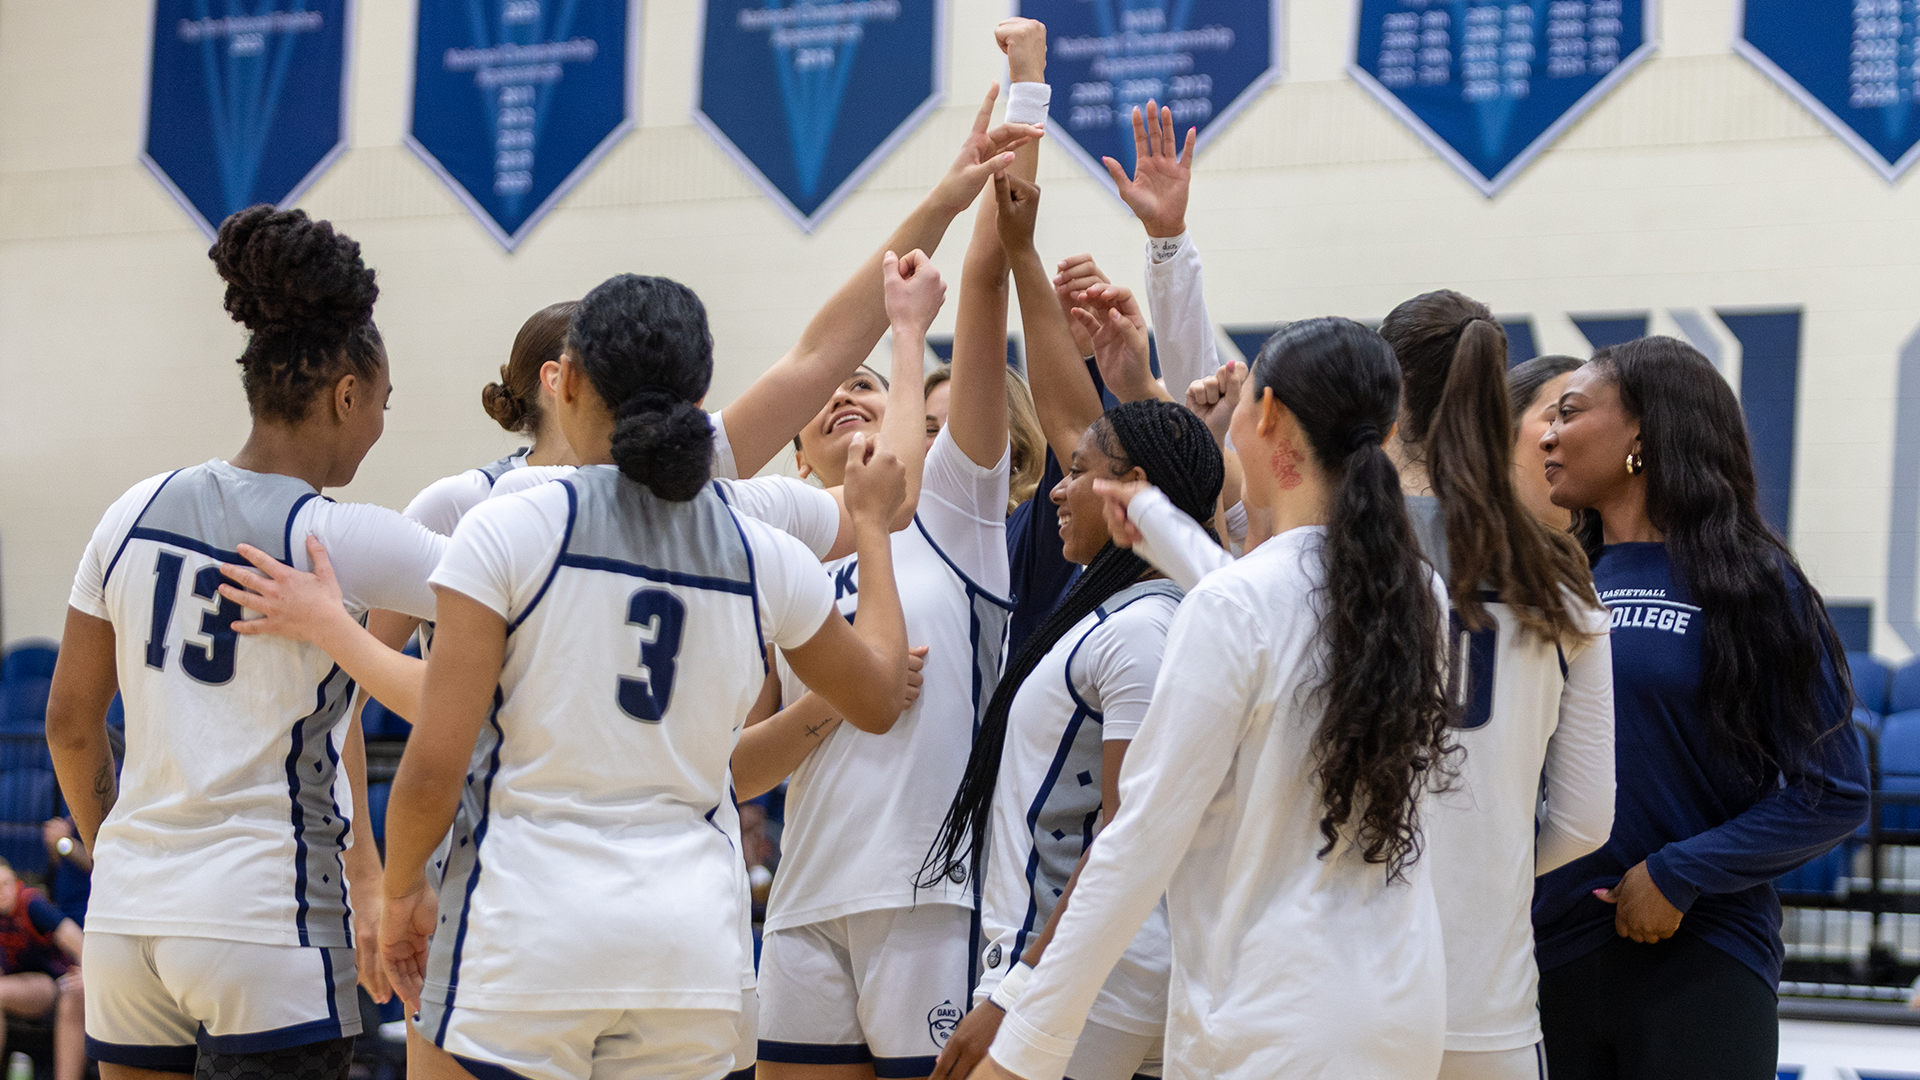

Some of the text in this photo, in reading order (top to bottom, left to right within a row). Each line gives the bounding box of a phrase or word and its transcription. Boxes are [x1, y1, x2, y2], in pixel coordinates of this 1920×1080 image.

[1602, 589, 1666, 599] BASKETBALL
[145, 548, 244, 686] 13
[1610, 606, 1691, 635] OLLEGE
[615, 585, 688, 725] 3
[937, 1009, 956, 1017] OAKS
